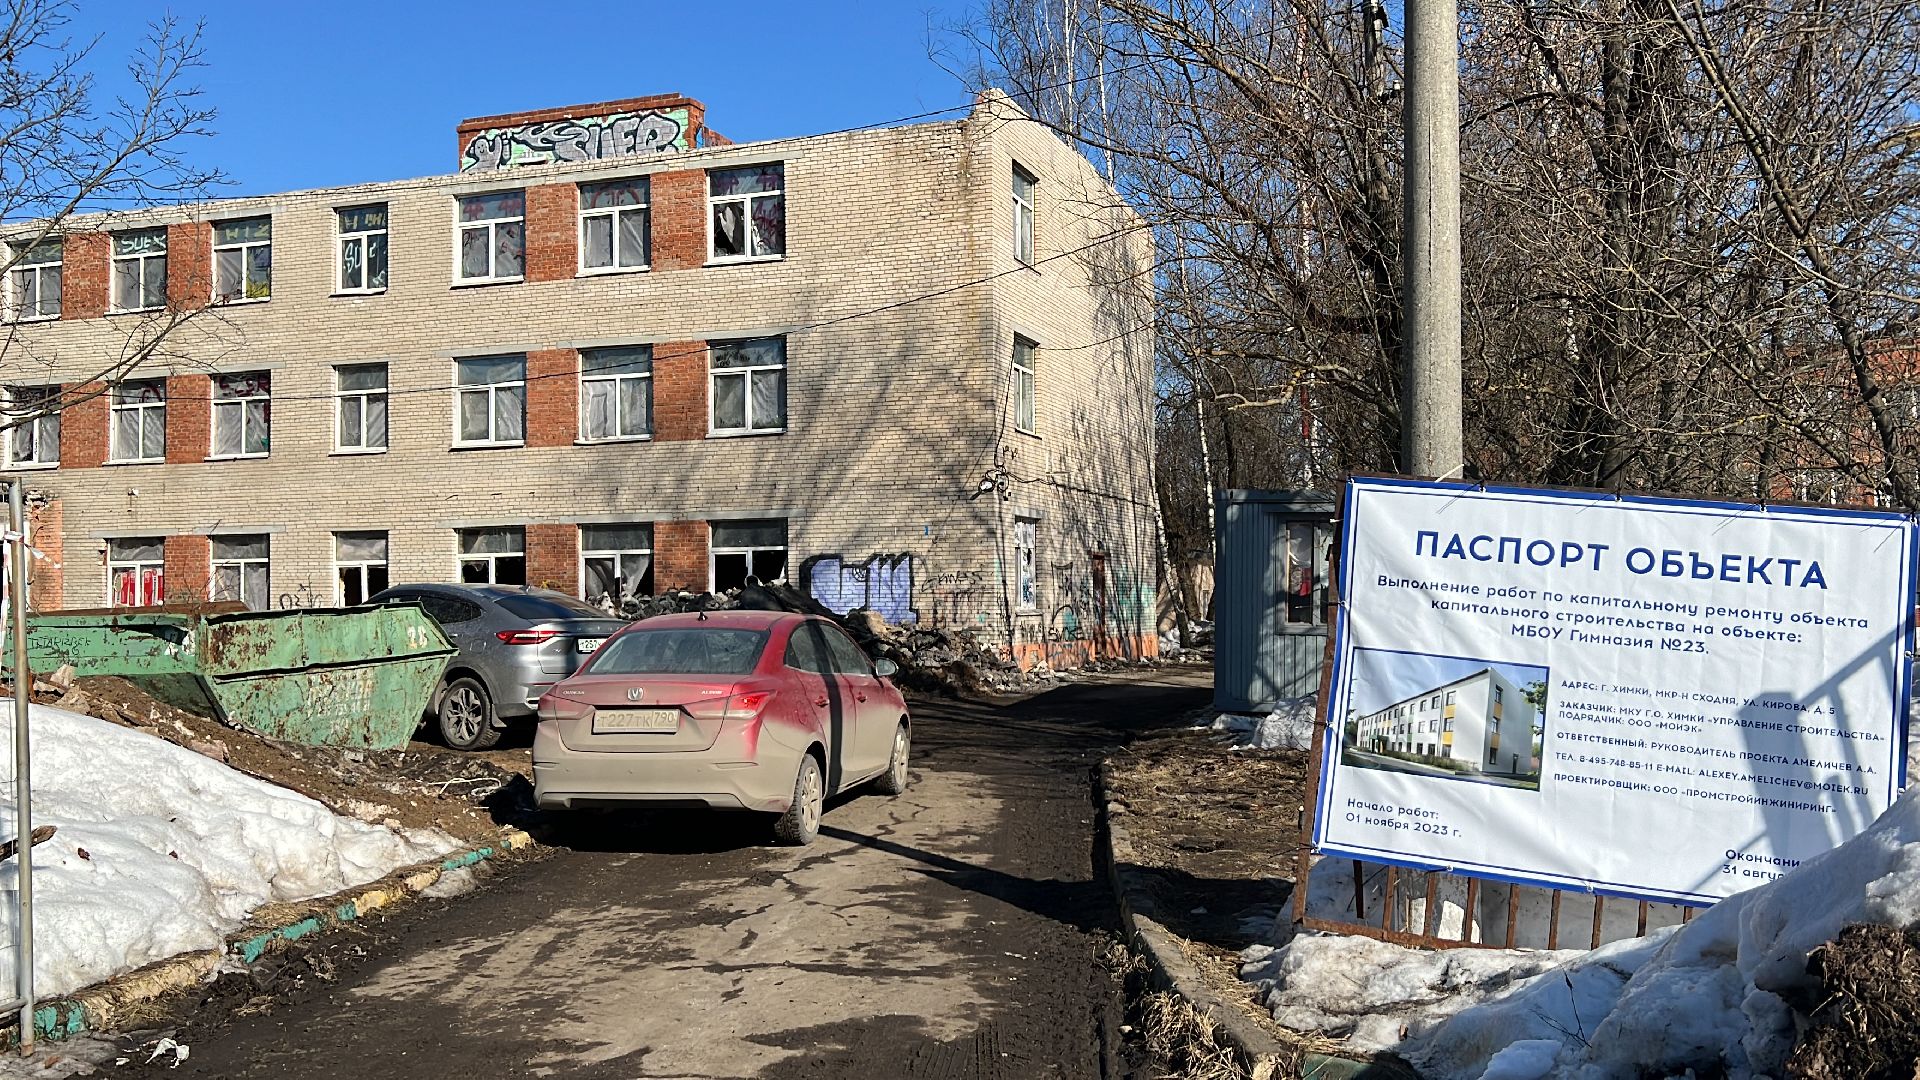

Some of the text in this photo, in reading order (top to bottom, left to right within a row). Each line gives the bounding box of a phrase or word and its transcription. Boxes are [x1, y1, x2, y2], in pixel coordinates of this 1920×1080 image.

[1415, 530, 1828, 590] ПАСПОРТ ОБЪЕКТА
[1377, 575, 1869, 628] Выполнение работ по капитальному ремонту объекта
[1431, 600, 1802, 643] капитального строительства на объекте:
[1511, 624, 1709, 655] МБОУ Гимназия №23.
[1561, 680, 1598, 691] АДРЕС:
[1601, 684, 1609, 692] Г.
[1613, 685, 1652, 697] ХИМКИ,
[1655, 690, 1689, 700] МКР-Н
[1692, 693, 1739, 706] СХОДНЯ,
[1743, 698, 1758, 707] УЛ.
[1762, 701, 1811, 713] КИРОВА,
[1813, 705, 1825, 714] Д.
[1559, 711, 1625, 725] ПОДРЯДЧИК:
[1628, 718, 1652, 728] ООО
[1560, 700, 1616, 713] ЗАКАЗЧИК:
[1619, 707, 1642, 716] МКУ
[1645, 709, 1664, 718] Г.О.
[1667, 712, 1704, 723] ХИМКИ
[1556, 731, 1877, 774] ОТВЕТСТВЕННЫЙ: РУКОВОДИТЕЛЬ ПРОЕКТА АМЕЛИЧЕВ А.А.
[1556, 752, 1576, 762] ТЕЛ.
[1656, 764, 1695, 776] E-MAIL:
[1554, 773, 1651, 792] ПРОЕКТИРОВЩИК:
[1653, 785, 1678, 795] ООО
[1347, 798, 1439, 819] Начало работ:
[1346, 812, 1462, 838] 01 ноября 2023 г.
[1722, 864, 1737, 875] 31
